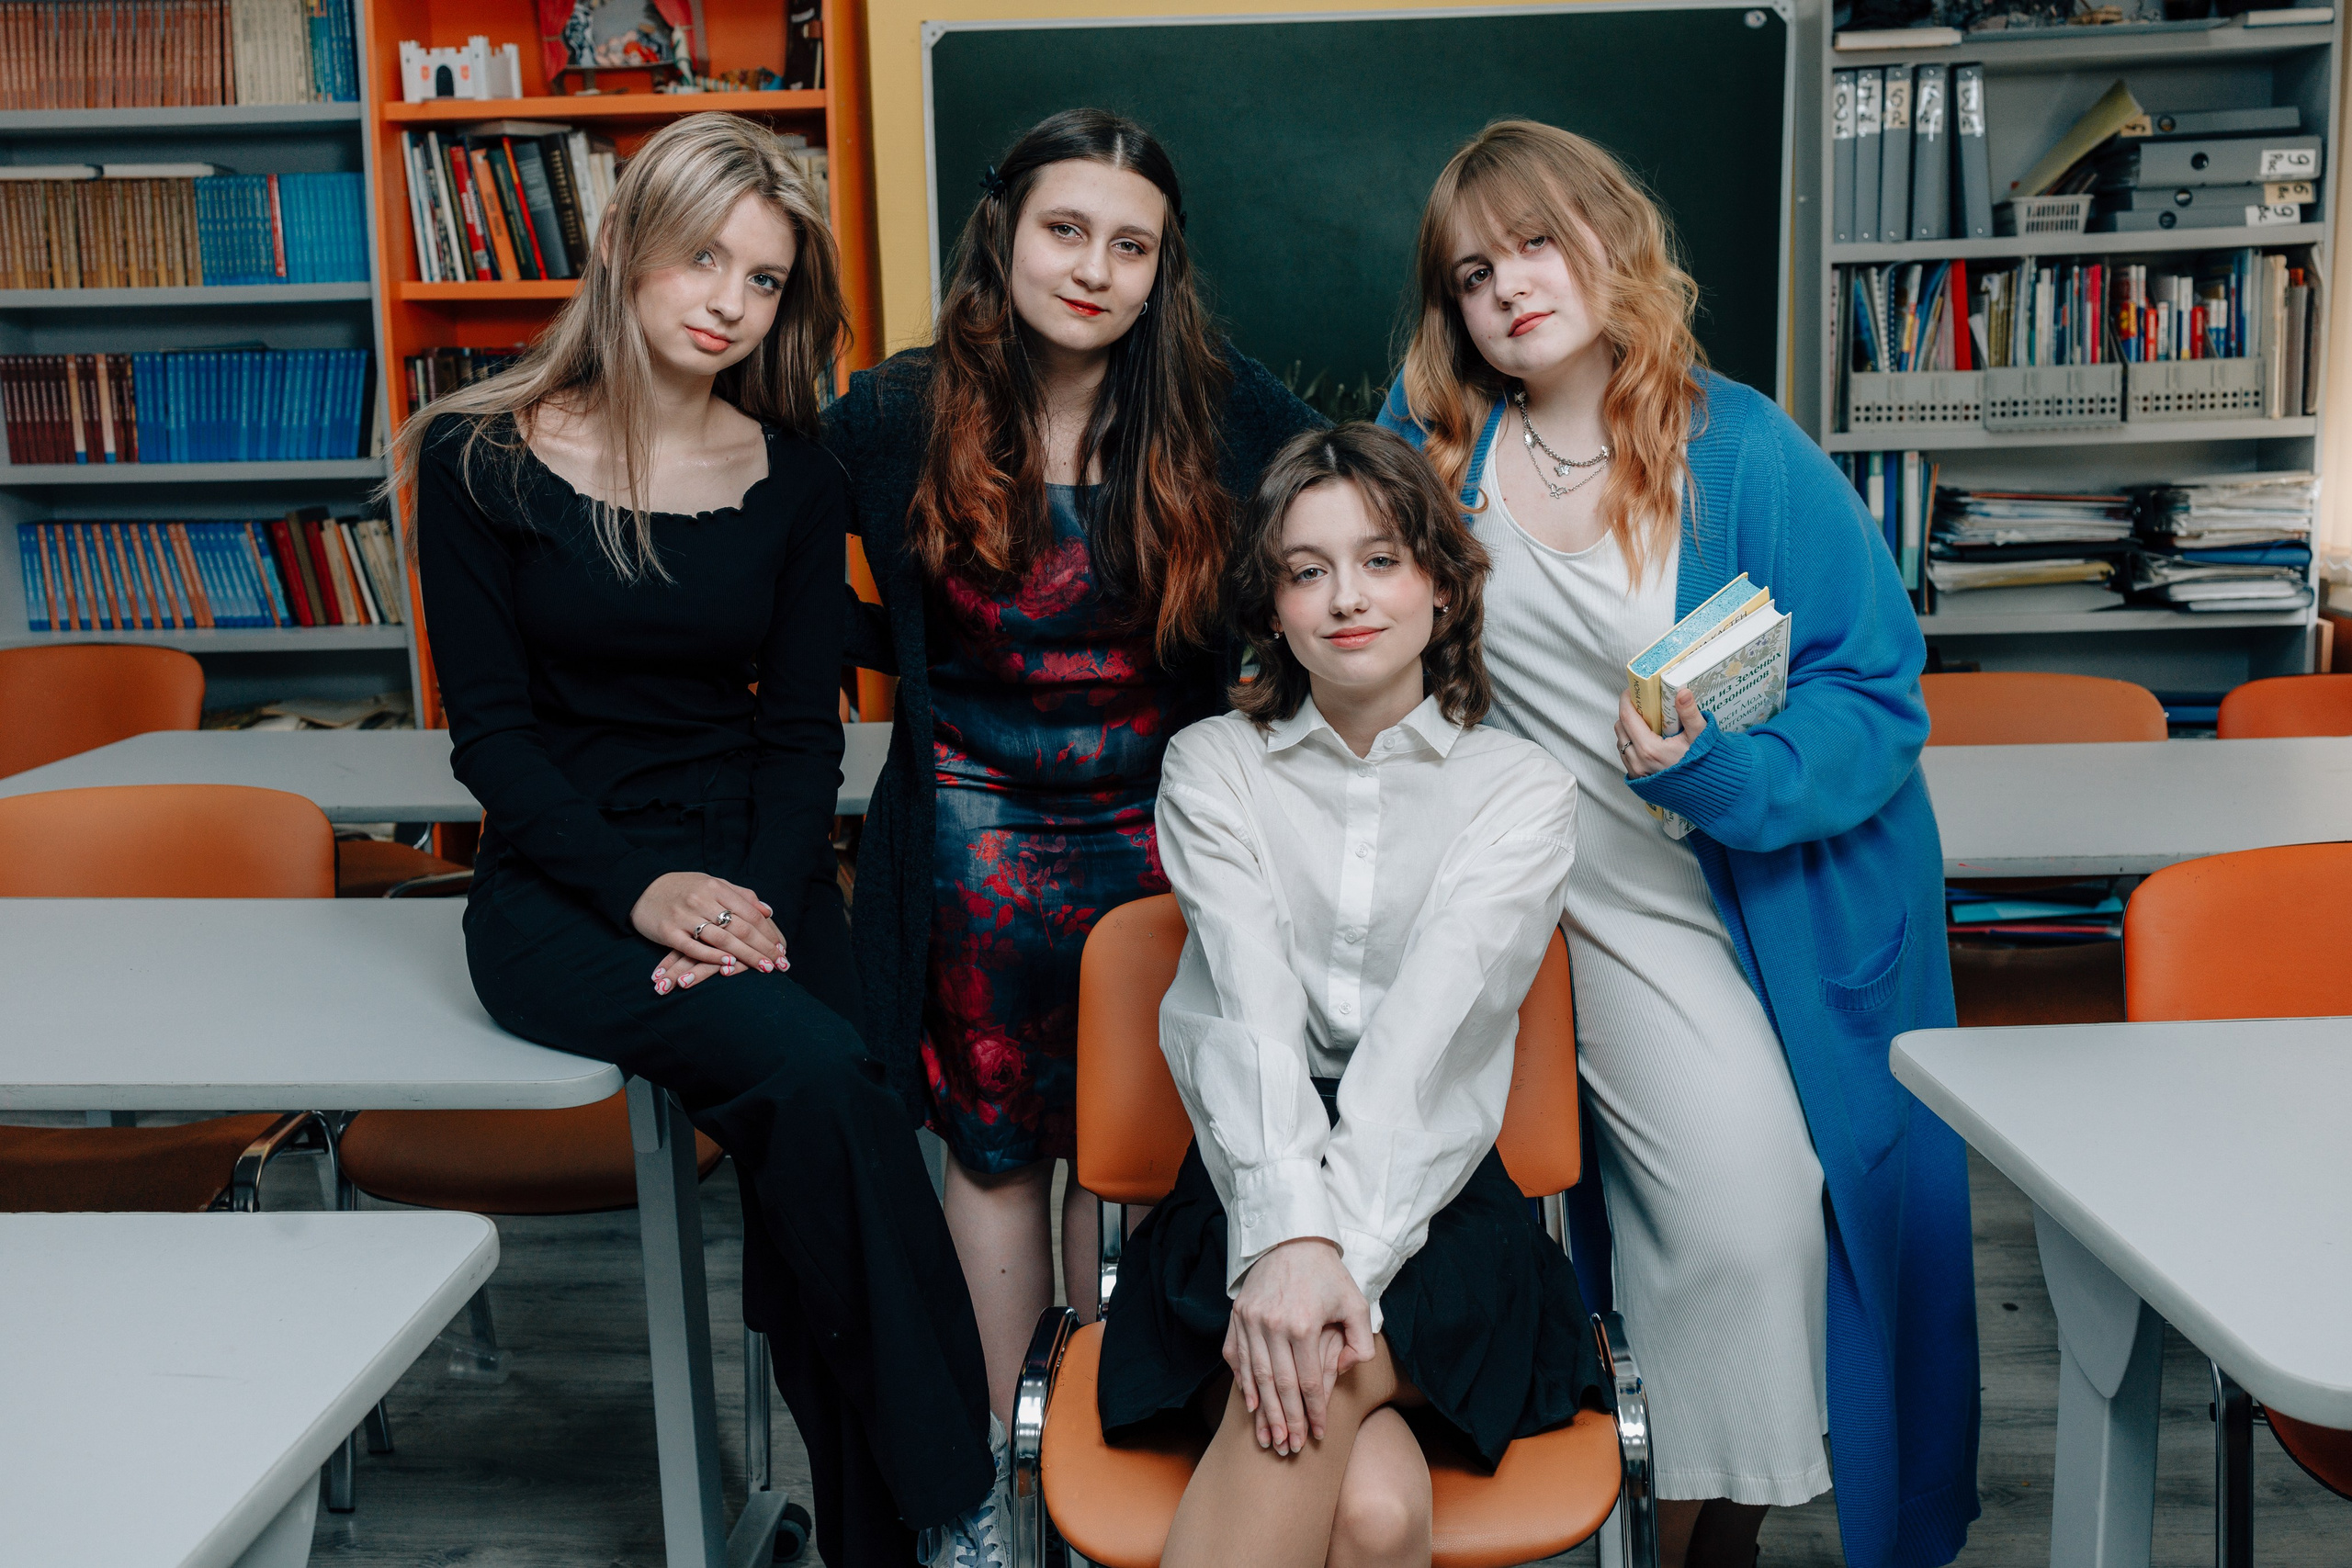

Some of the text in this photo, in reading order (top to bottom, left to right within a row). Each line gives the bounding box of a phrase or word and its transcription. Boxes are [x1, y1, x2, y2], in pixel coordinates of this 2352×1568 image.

[1891, 88, 1904, 107] 6
[2289, 153, 2311, 166] 9
[2273, 205, 2294, 218] 9
[1719, 685, 1732, 697] из
[1736, 652, 1781, 686] Зеленых
[1706, 671, 1770, 713] Мезонинов
[1718, 693, 1762, 726] юси Мод
[1720, 699, 1768, 733] нтгомери
